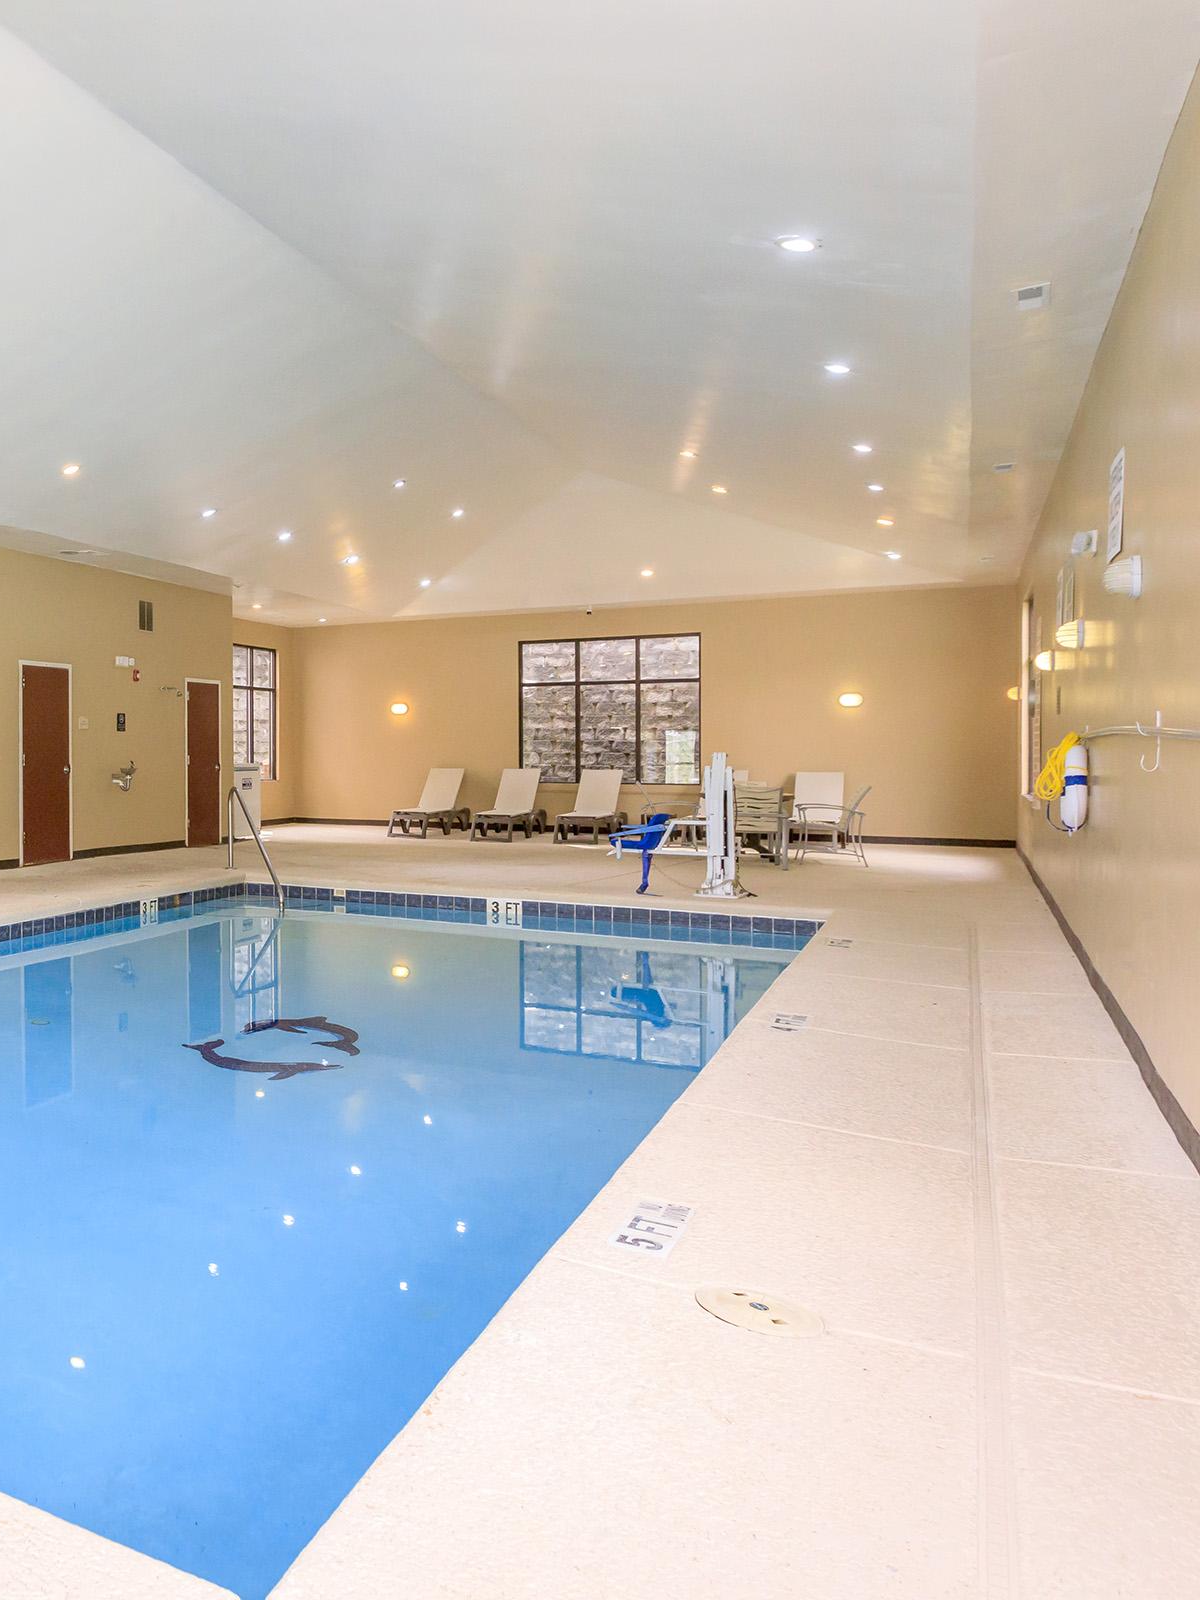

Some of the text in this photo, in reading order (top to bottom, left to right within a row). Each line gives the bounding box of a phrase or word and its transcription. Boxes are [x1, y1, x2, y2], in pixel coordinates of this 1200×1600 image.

[492, 901, 520, 914] 3 FT
[616, 1216, 678, 1250] 5 FT
